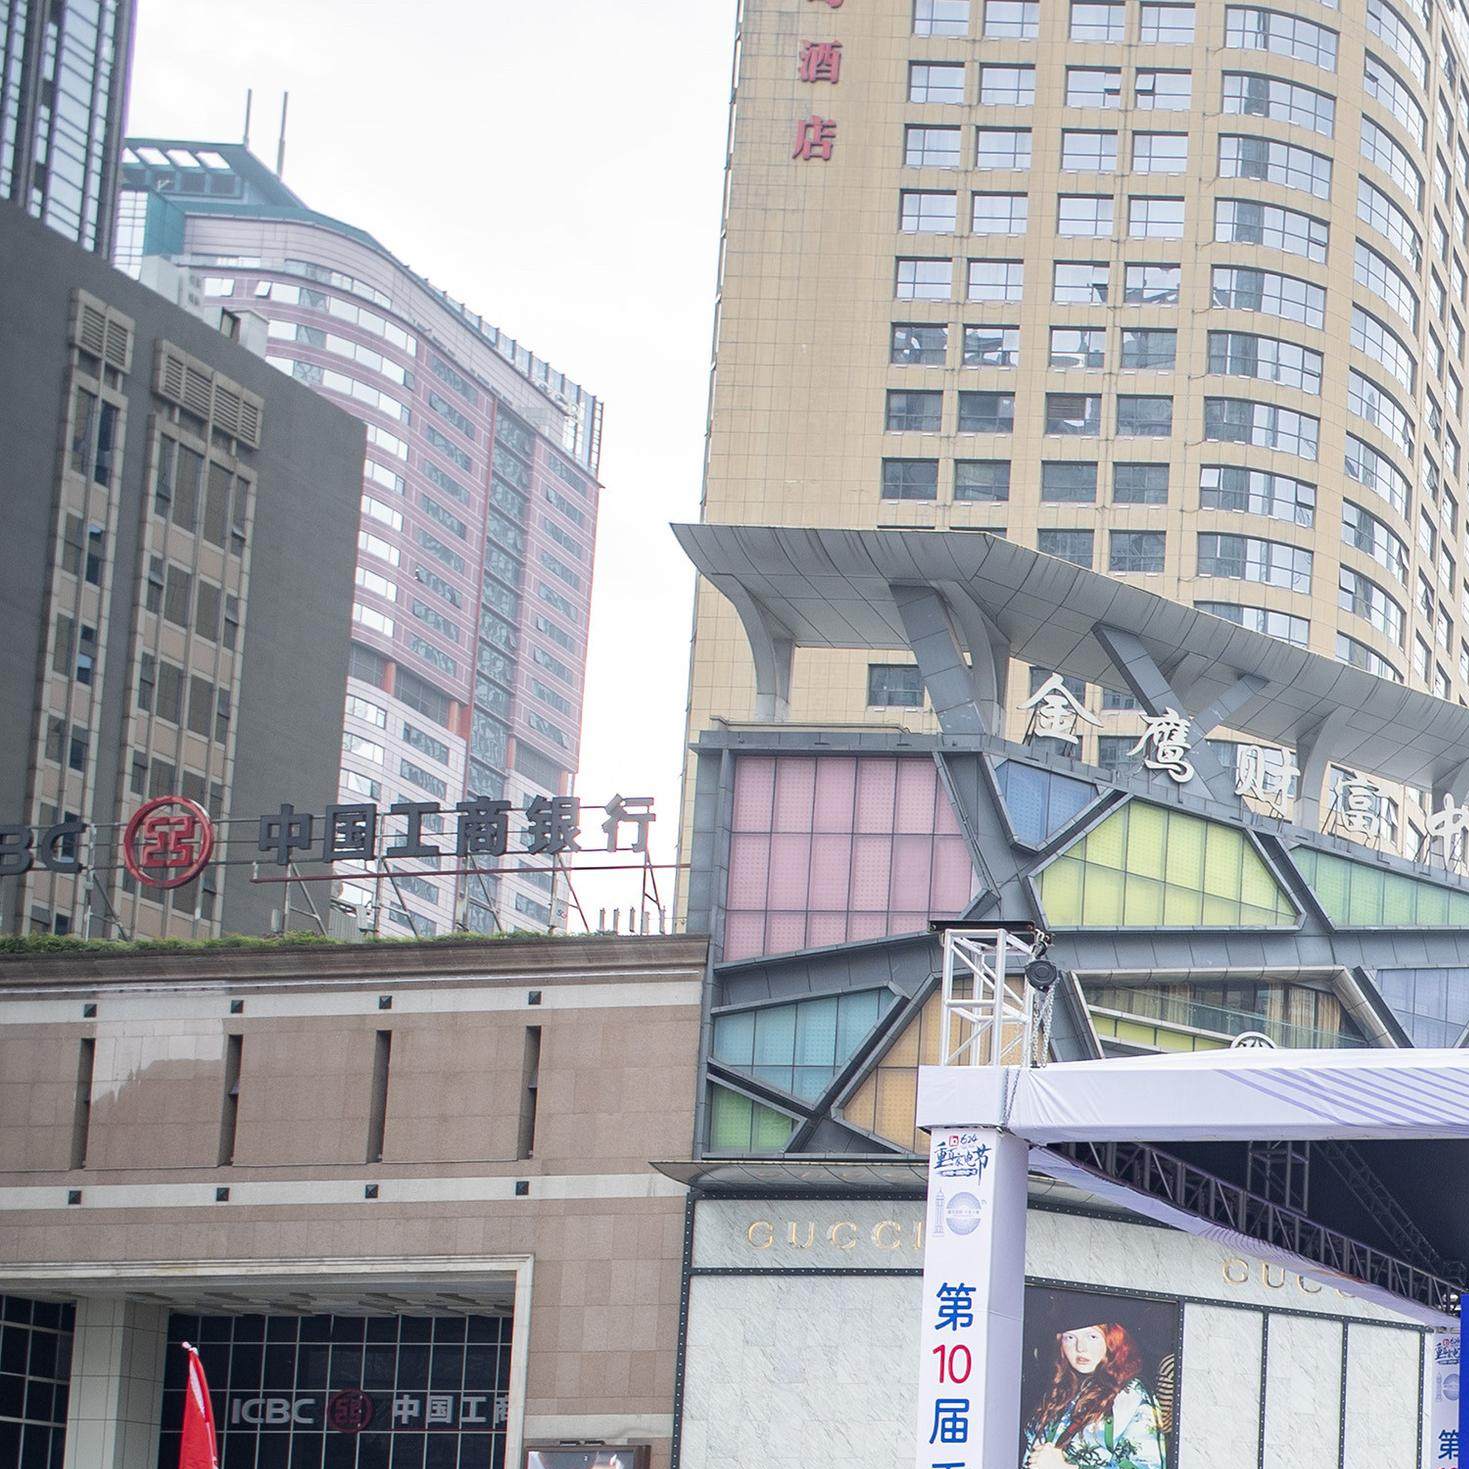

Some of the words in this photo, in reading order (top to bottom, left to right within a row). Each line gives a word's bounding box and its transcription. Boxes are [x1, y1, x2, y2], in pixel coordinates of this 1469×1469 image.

[258, 793, 656, 866] 中国工商银行
[747, 1219, 924, 1251] GUCCI
[231, 1397, 316, 1424] ICBC
